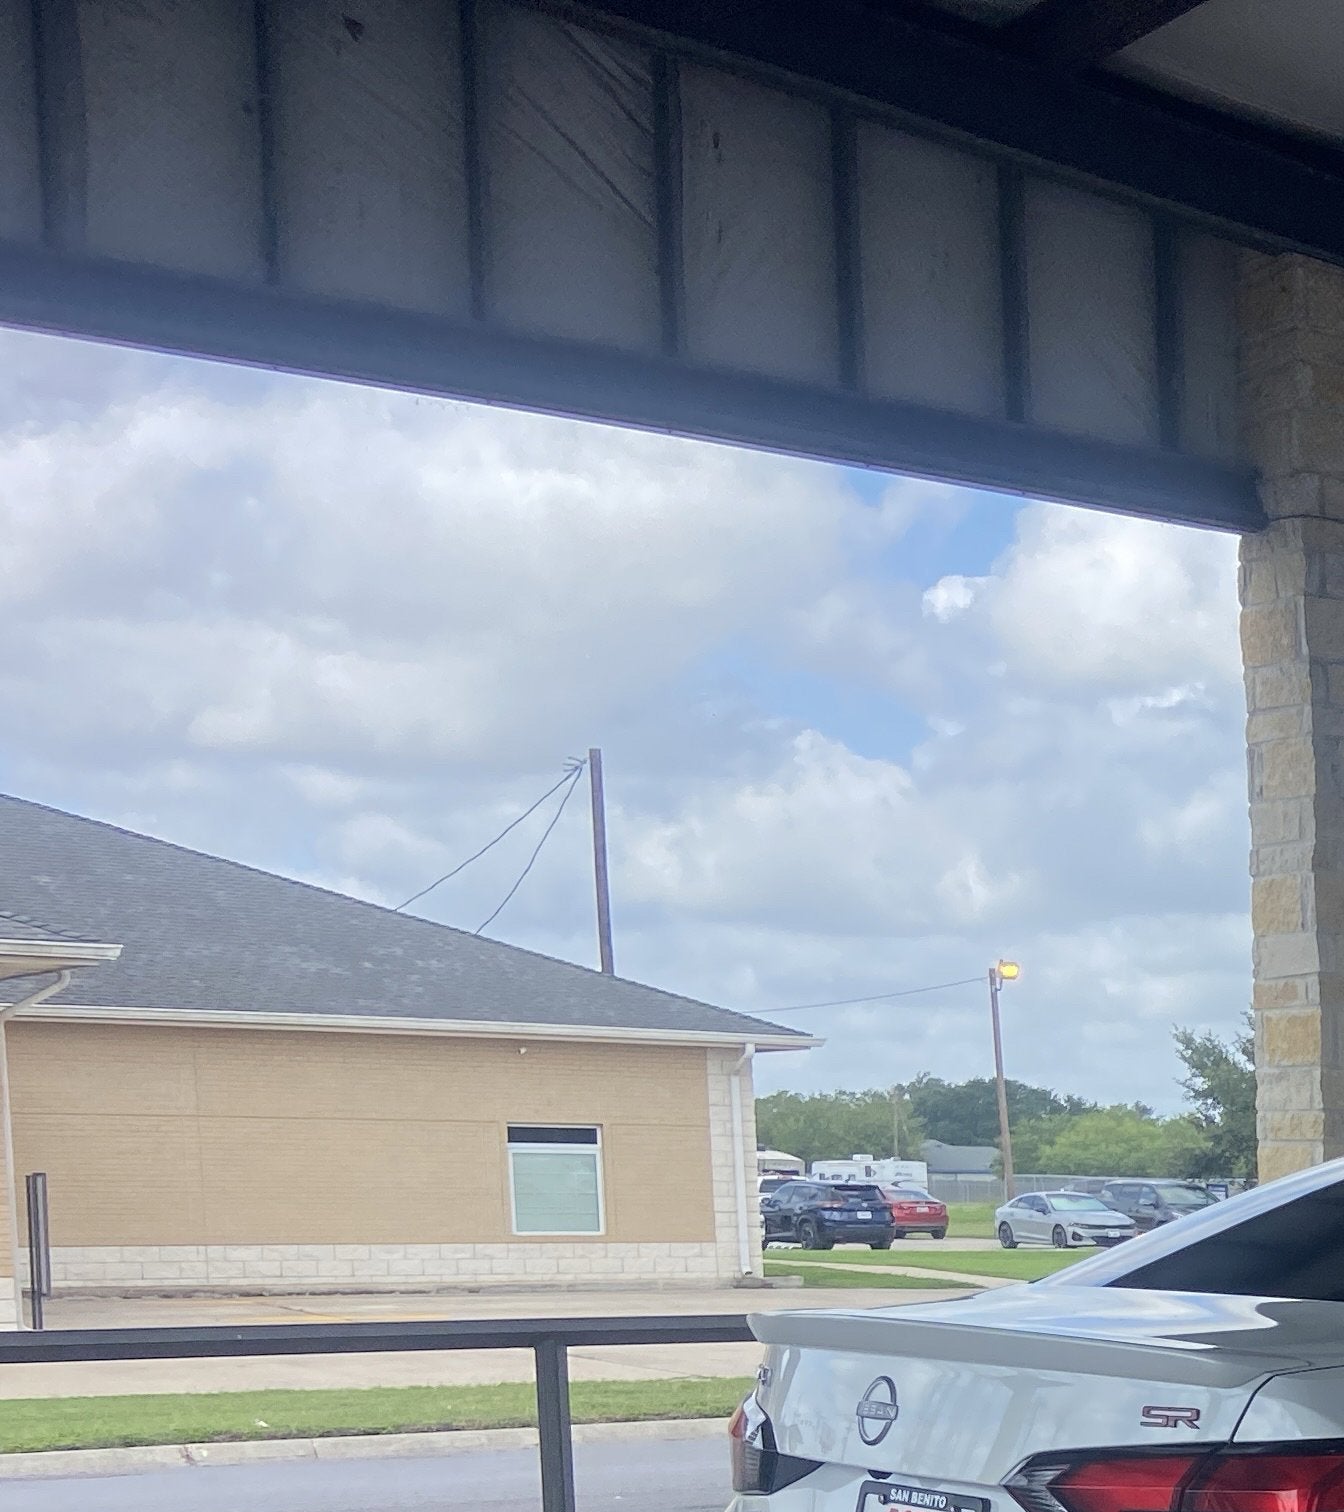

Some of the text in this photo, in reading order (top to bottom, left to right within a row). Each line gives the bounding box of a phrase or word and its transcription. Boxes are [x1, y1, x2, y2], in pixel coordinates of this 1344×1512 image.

[1140, 1405, 1201, 1430] SR
[889, 1488, 947, 1509] SAN BENITO
